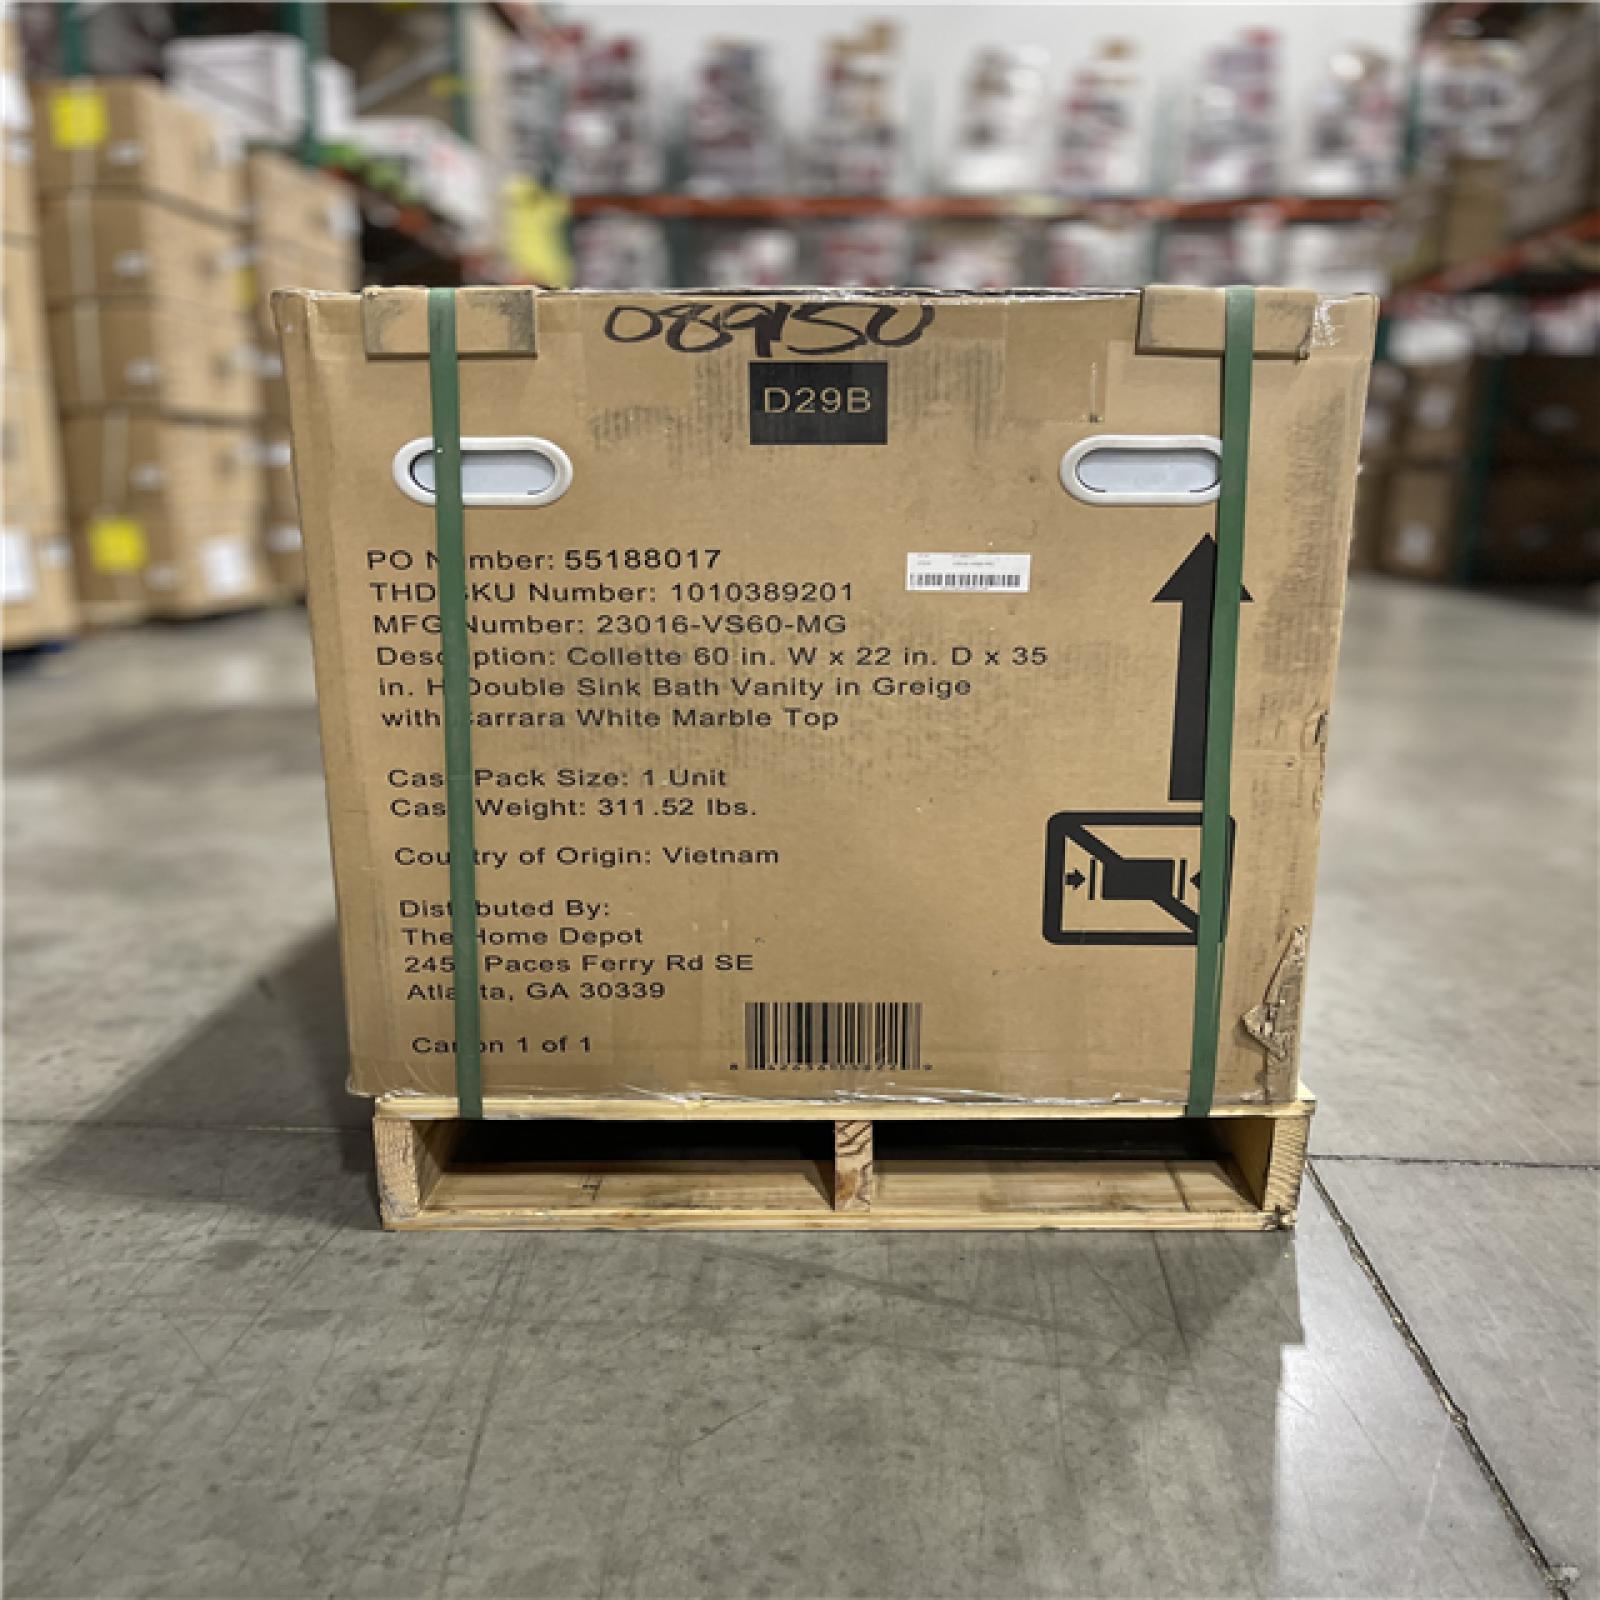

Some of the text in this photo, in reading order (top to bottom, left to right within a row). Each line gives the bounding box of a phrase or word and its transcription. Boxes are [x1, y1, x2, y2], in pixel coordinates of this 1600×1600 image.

[763, 386, 872, 413] D29B
[366, 549, 721, 571] PO Nmber: 55188017
[369, 582, 851, 603] THD KU Number: 1010389201
[374, 614, 442, 634] MFG
[597, 614, 846, 634] 23016-VS60-MG
[566, 646, 681, 666] Collette
[694, 646, 729, 666] 60
[741, 646, 776, 666] in.
[787, 646, 818, 666] W
[829, 651, 844, 666] x
[856, 646, 891, 666] 22
[904, 646, 936, 666] in.
[951, 646, 973, 666] D
[984, 651, 999, 666] x
[1012, 646, 1048, 666] 35
[379, 677, 414, 696] in.
[576, 676, 642, 697] Sink
[653, 677, 719, 697] Bath
[730, 677, 824, 701] Vanity
[836, 677, 861, 696] in
[872, 676, 971, 701] Greige
[381, 707, 839, 731] with arrara White Marble Top
[387, 769, 727, 788] Cas Pack Size: 1 Unit
[389, 797, 757, 821] Cas Weight: 311.52 lbs.
[394, 846, 779, 871] Coutry of Origin: Vietnam
[399, 899, 610, 921] Distbuted By:
[401, 927, 453, 946] The
[559, 926, 643, 948] Depot
[404, 954, 754, 976] 245 Paces Ferry Rd SE
[406, 981, 666, 1003] Atlata, GA 30339
[516, 1035, 529, 1054] 1
[541, 1034, 569, 1056] of
[578, 1035, 591, 1054] 1
